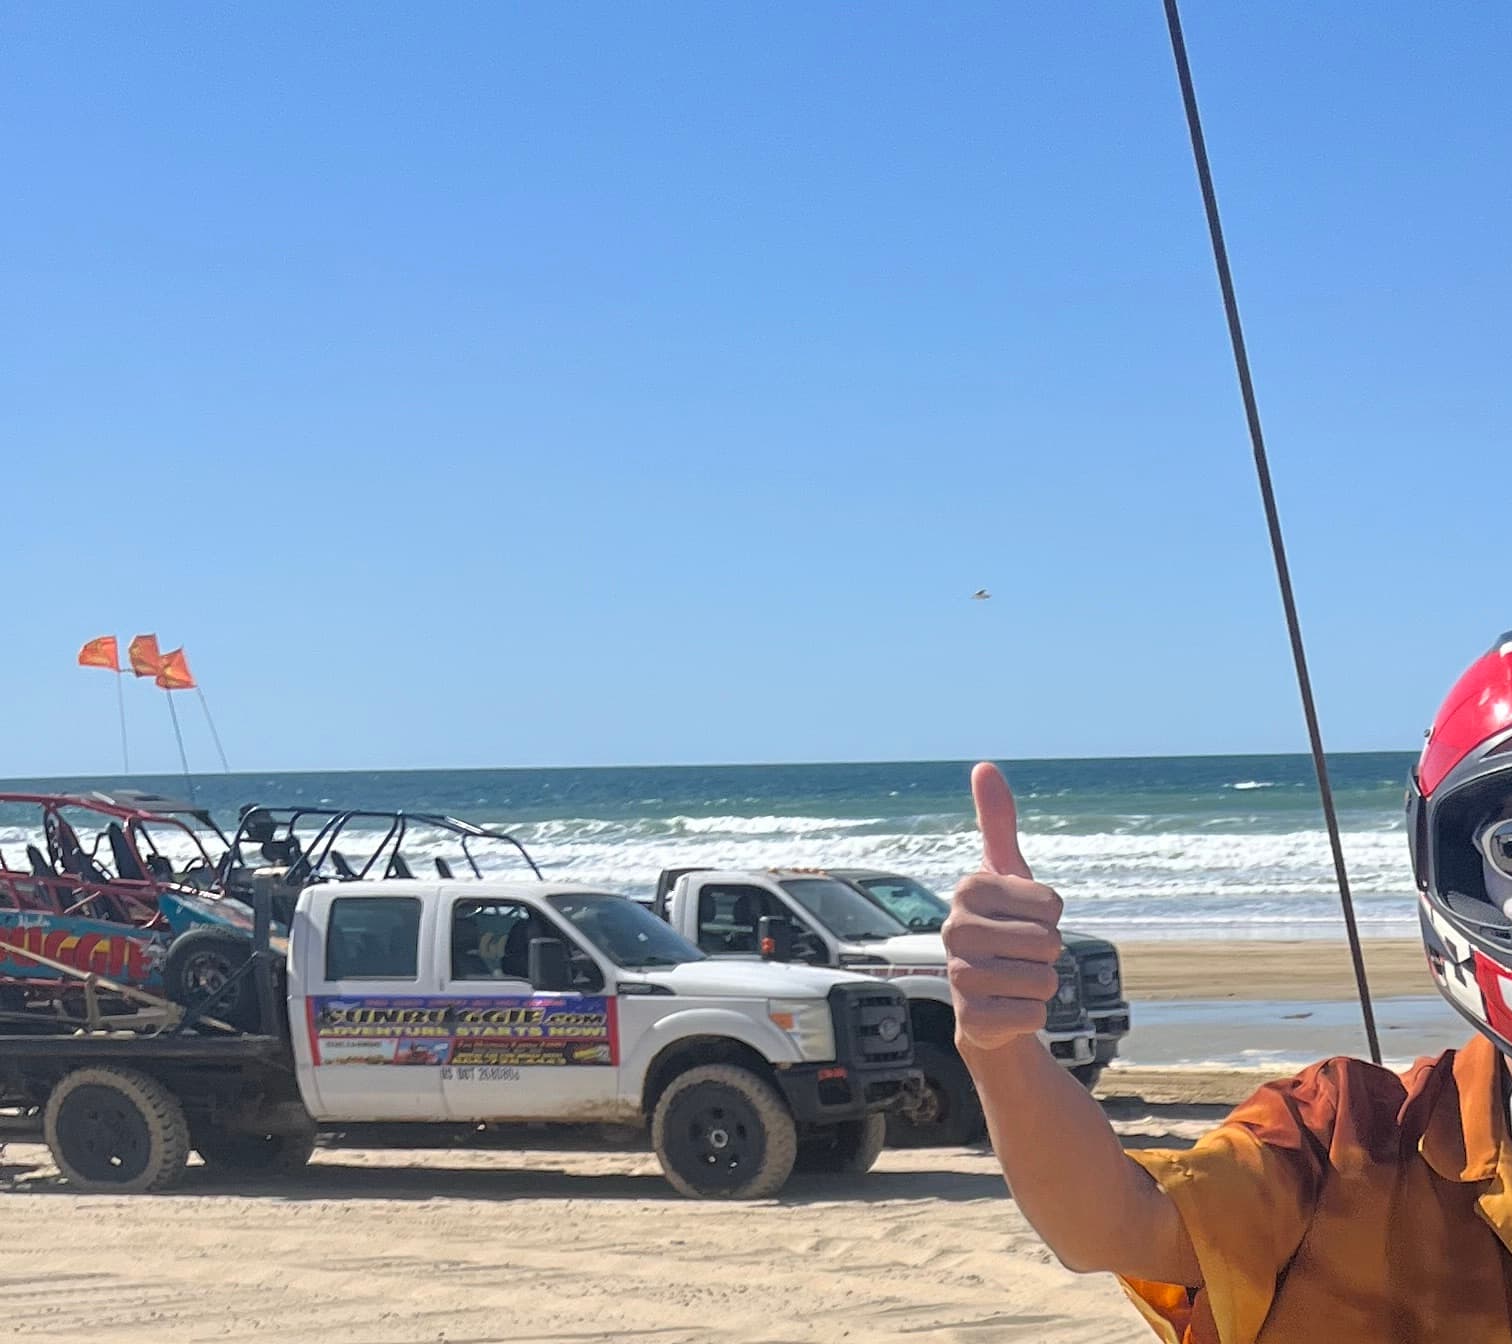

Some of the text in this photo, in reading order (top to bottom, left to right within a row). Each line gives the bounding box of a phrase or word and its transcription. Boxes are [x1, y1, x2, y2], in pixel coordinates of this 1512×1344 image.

[0, 927, 151, 980] UGGIE
[319, 1027, 606, 1036] ADVENTURE STARTS NOW!
